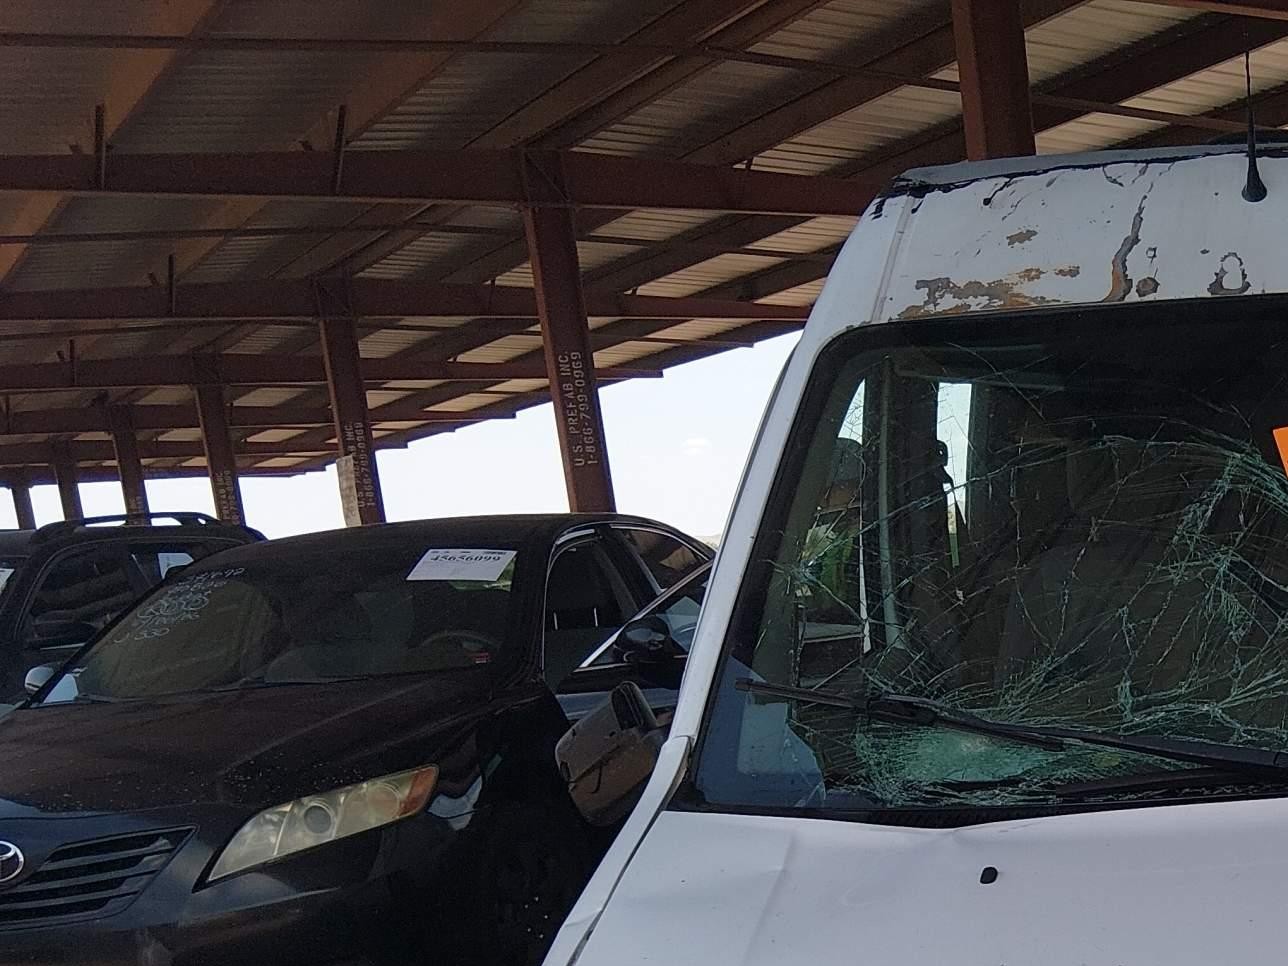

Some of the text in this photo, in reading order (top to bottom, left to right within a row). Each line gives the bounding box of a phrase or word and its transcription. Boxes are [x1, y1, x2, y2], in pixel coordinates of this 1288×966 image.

[557, 351, 571, 376] INC.
[562, 383, 580, 434] PREFAB
[570, 351, 598, 465] 1-866-799-0969
